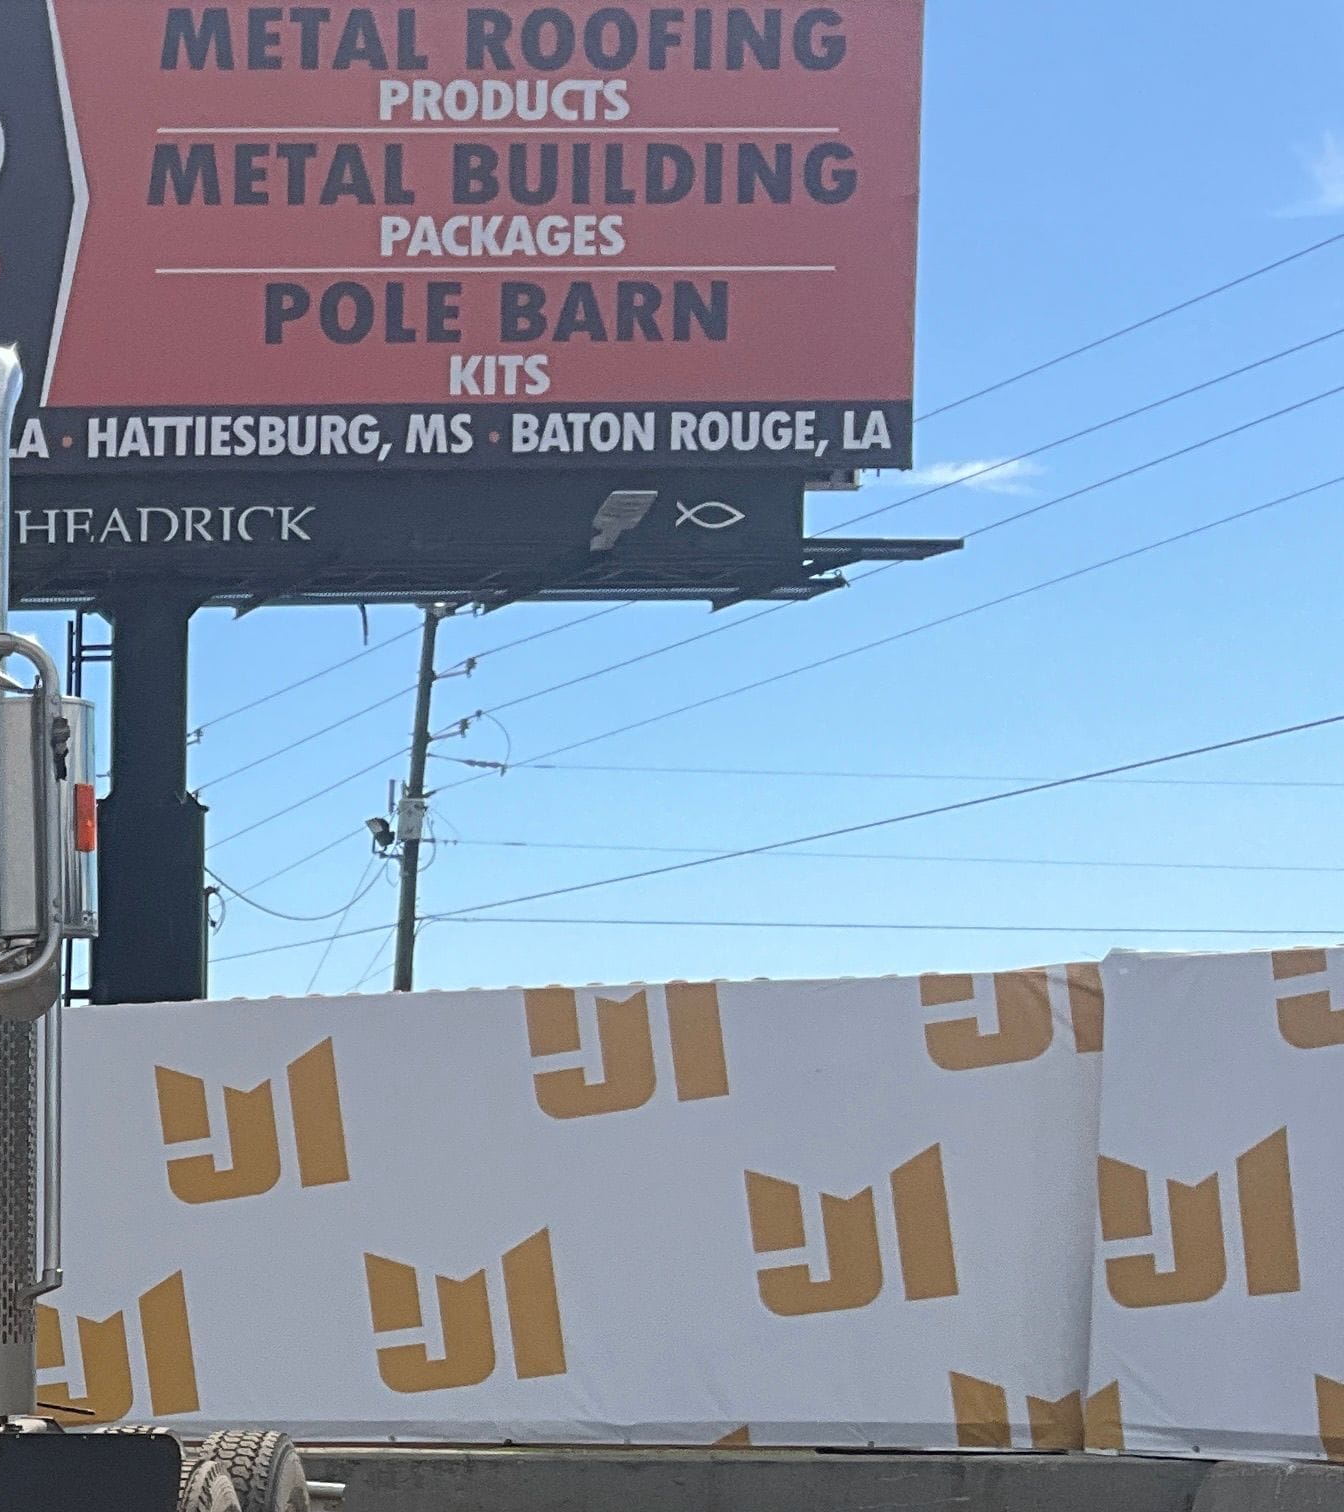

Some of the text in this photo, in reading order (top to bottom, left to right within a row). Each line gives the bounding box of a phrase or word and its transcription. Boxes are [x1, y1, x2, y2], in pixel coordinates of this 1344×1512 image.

[159, 6, 848, 72] METAL ROOFING
[379, 79, 630, 122] PRODUCTS
[147, 141, 859, 206] METAL BUILDING
[380, 215, 626, 257] PACKAGES
[264, 280, 729, 345] POLE BARN
[449, 354, 550, 396] KITS
[87, 414, 391, 462] HATTIESBURG,
[405, 412, 474, 454] MS
[512, 412, 663, 453] BATON
[671, 411, 827, 457] ROUGE,
[842, 410, 892, 451] LA
[14, 506, 317, 545] HEADRICK
